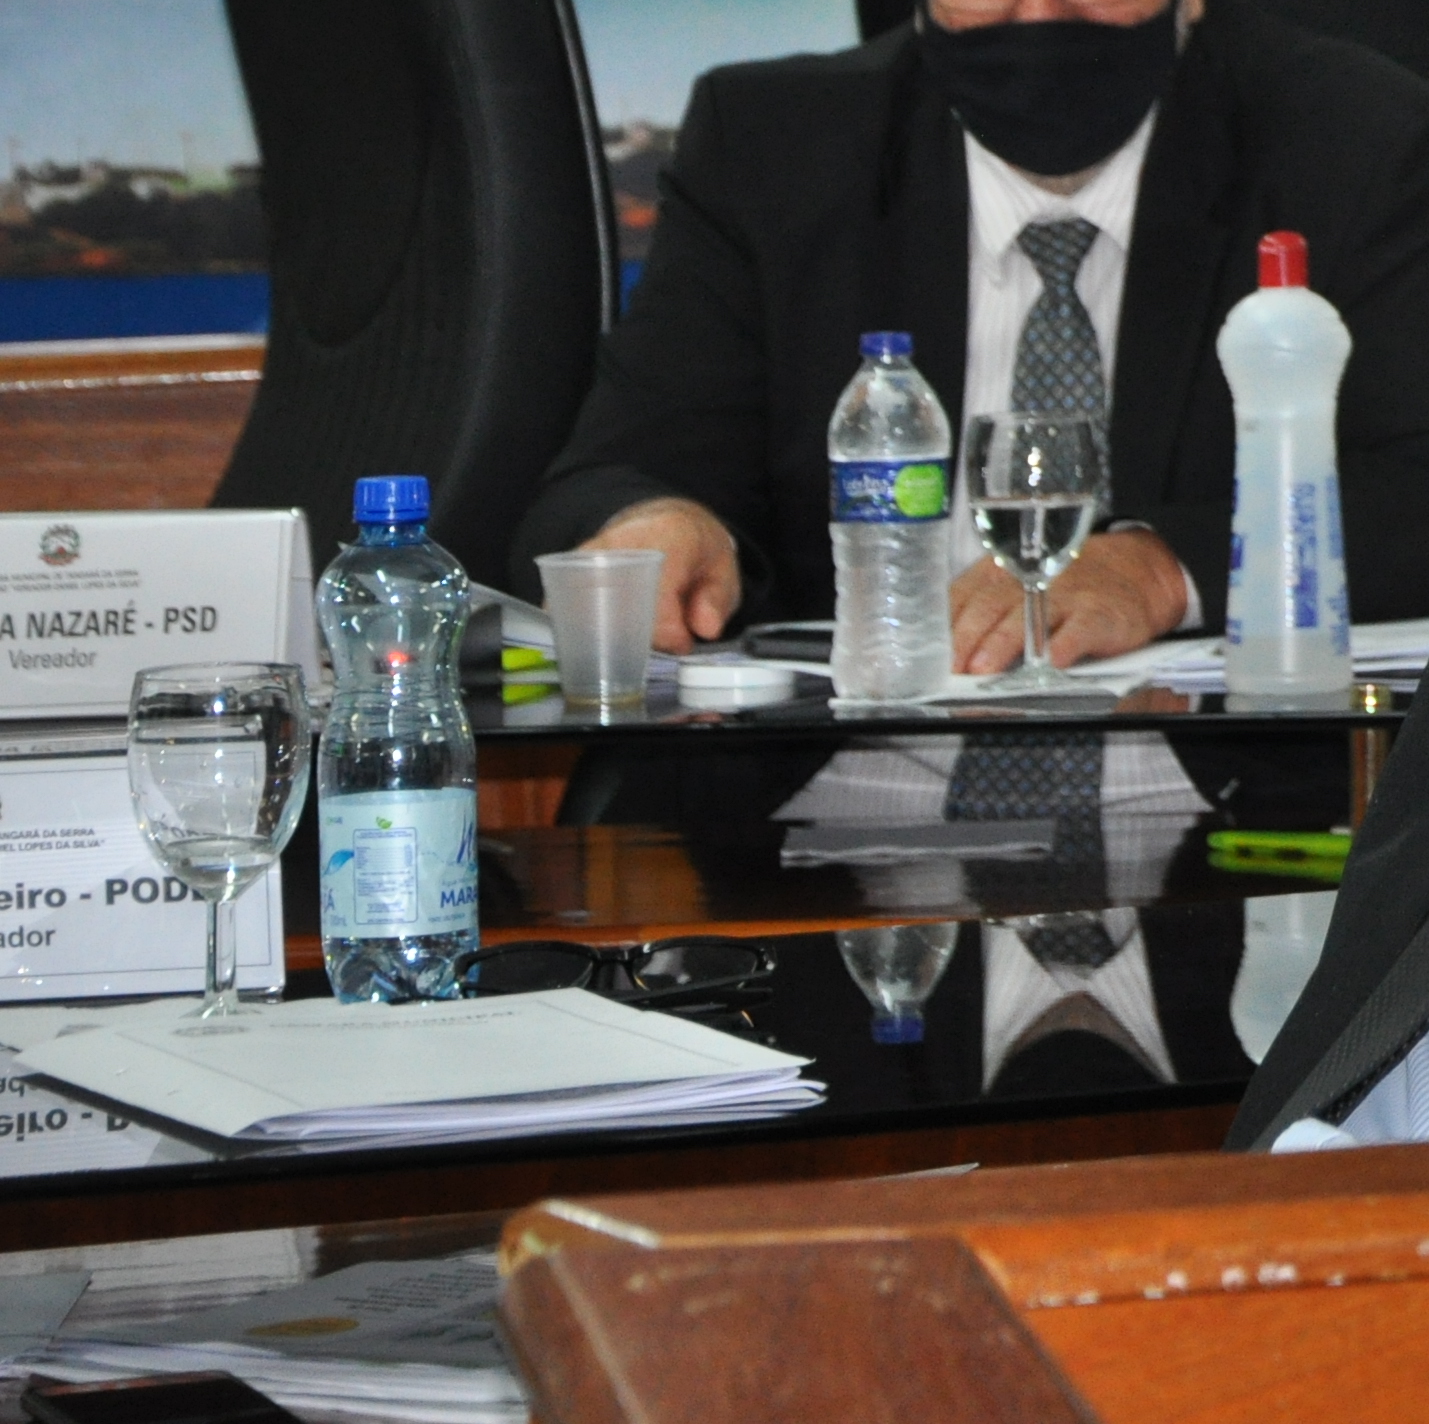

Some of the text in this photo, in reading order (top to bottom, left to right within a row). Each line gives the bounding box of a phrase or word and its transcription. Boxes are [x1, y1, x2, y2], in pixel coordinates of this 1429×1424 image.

[26, 600, 138, 638] NAZARÉ
[163, 605, 218, 634] PSD
[8, 647, 97, 670] Vereador
